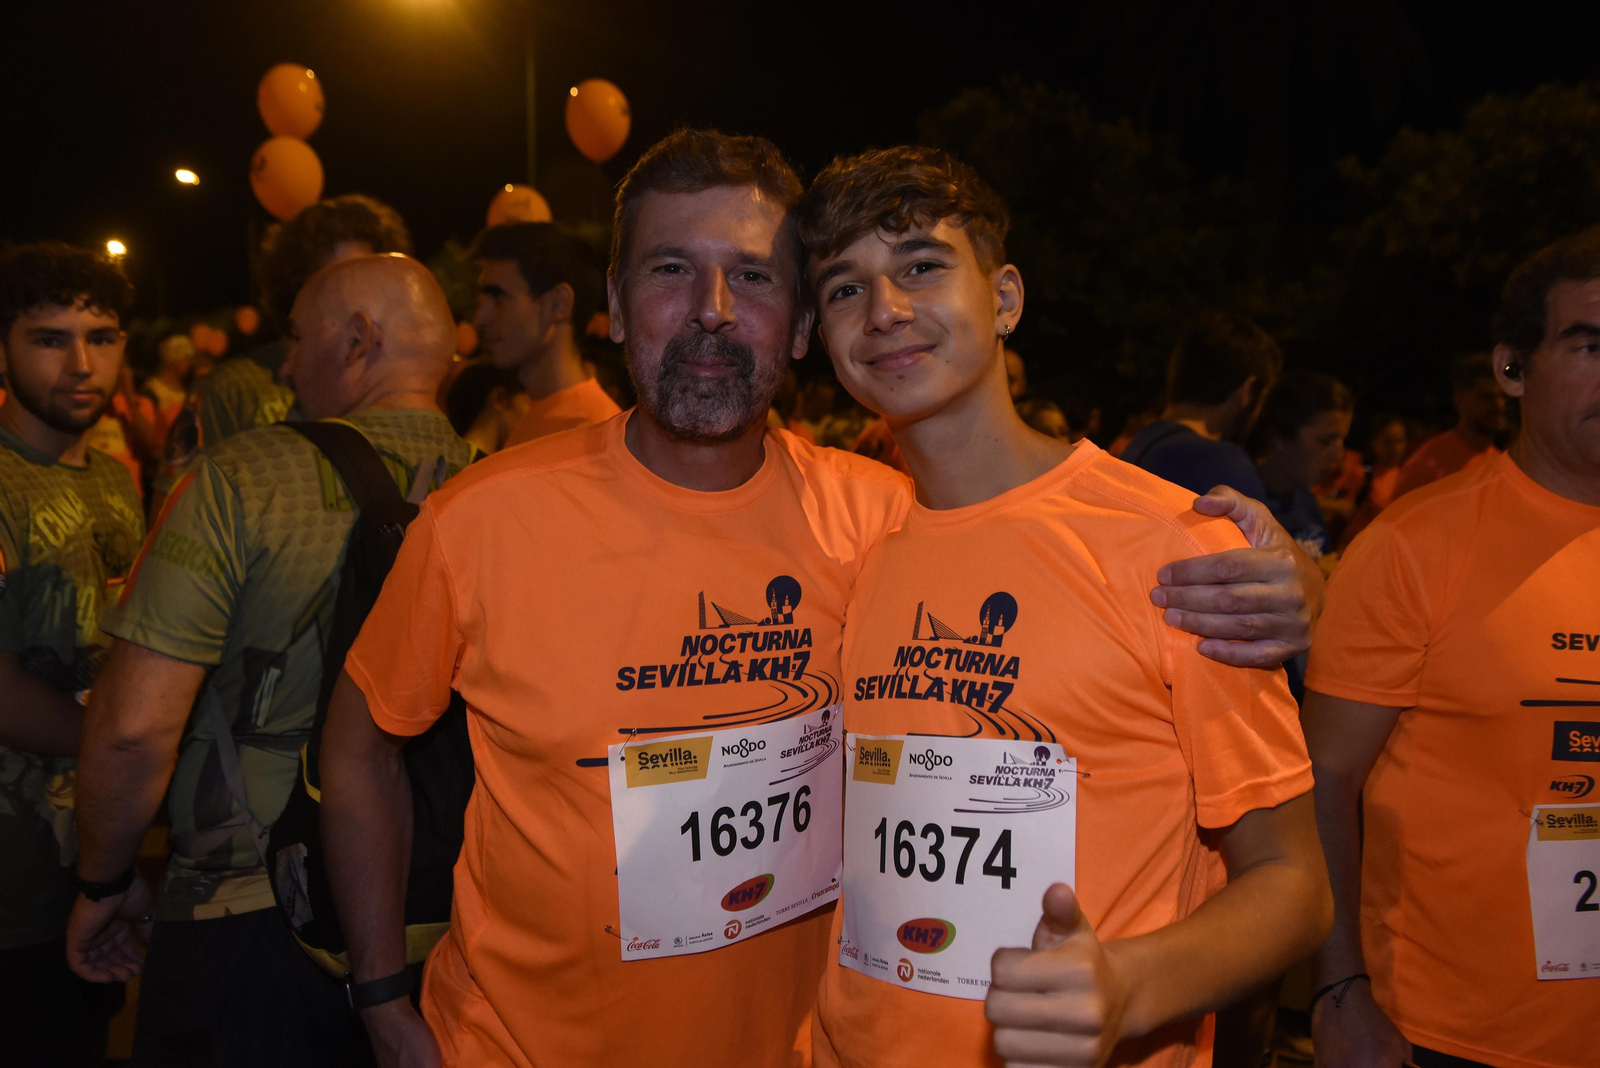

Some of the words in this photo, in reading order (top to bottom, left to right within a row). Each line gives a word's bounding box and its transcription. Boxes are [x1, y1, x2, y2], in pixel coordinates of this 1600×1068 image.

[680, 628, 813, 657] NOCTURNA
[893, 645, 1020, 680] NOCTURNA
[616, 659, 742, 691] SEVILLA
[854, 674, 945, 702] SEVILLA
[798, 725, 832, 745] NOCTURNA
[780, 741, 815, 759] SEVILLA
[969, 774, 1021, 787] SEVILLA
[994, 765, 1056, 777] NOCTURNA
[680, 785, 812, 862] 16376
[874, 817, 1017, 890] 16374
[811, 882, 840, 900] Cruzcampo
[1573, 870, 1600, 912] 2
[775, 905, 791, 916] TORRE
[791, 898, 809, 910] SEVILLA
[957, 977, 979, 987] TORRE
